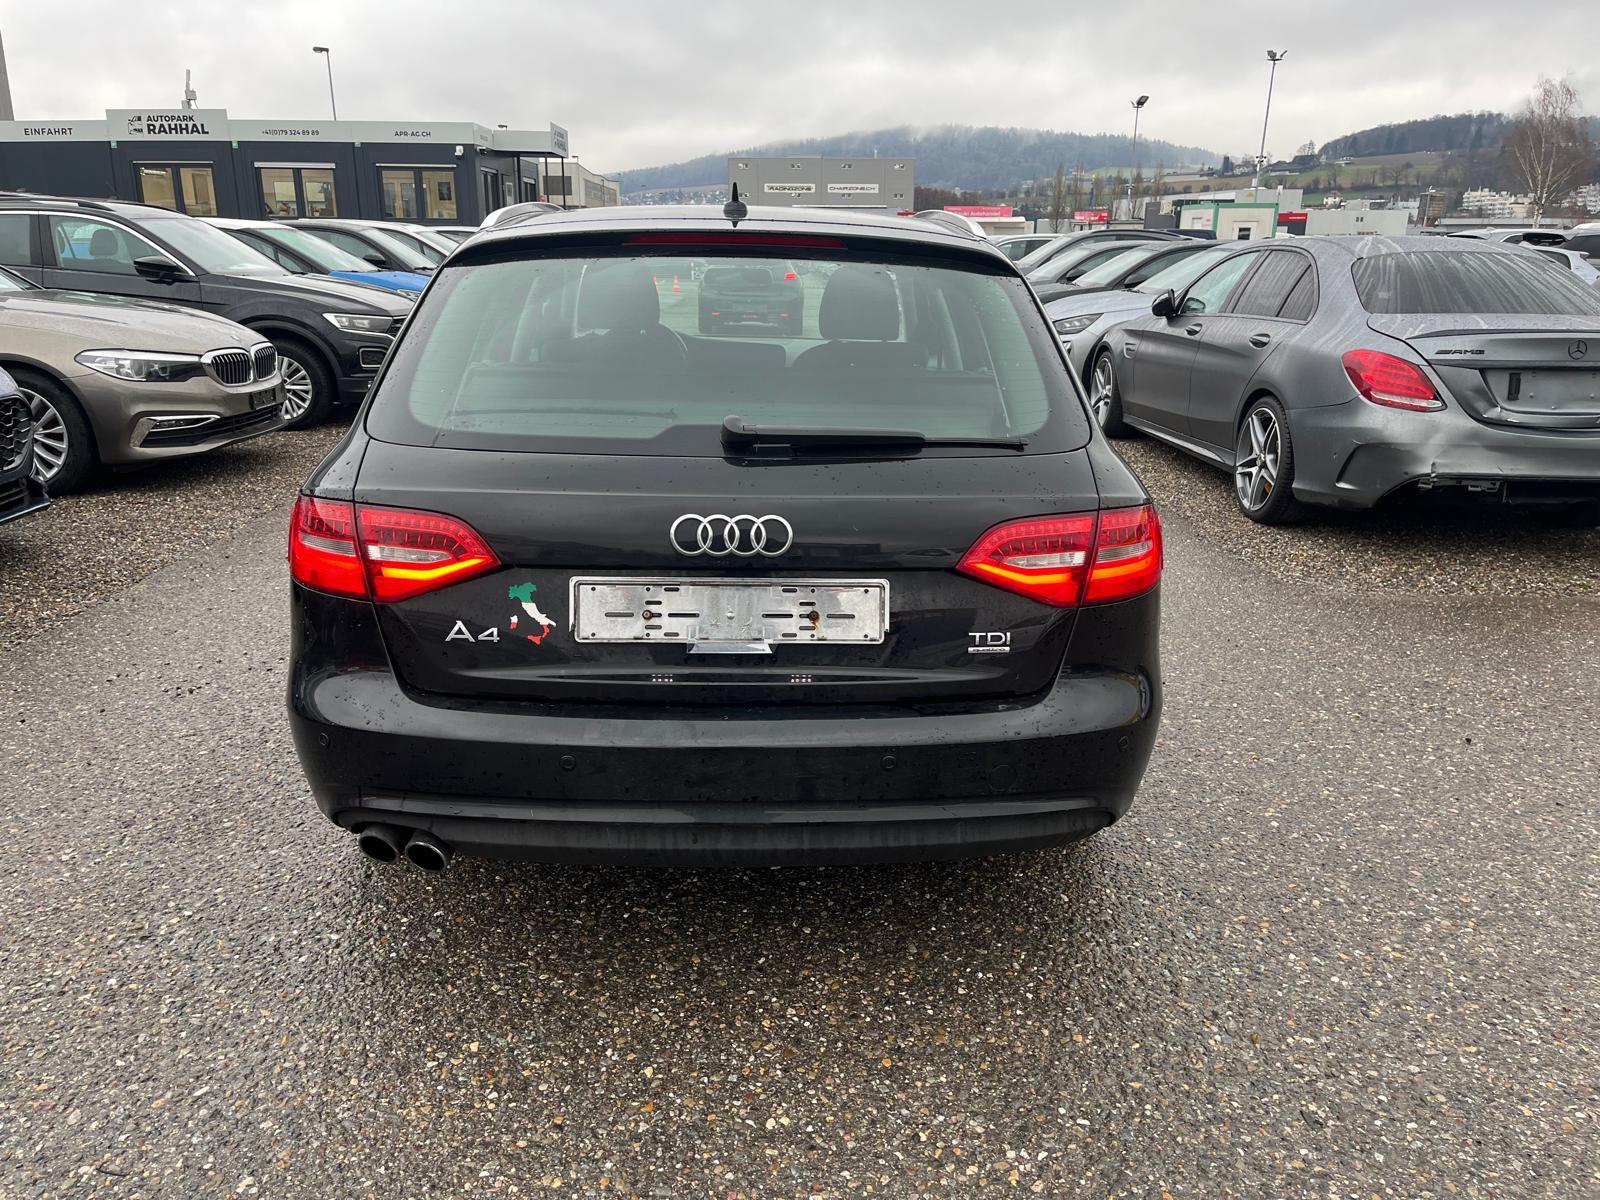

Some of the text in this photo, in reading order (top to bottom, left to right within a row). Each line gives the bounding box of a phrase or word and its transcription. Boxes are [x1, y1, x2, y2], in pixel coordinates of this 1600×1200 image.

[146, 115, 195, 123] AUTOPARK
[24, 127, 73, 136] EINFAHRT
[147, 123, 209, 135] RAHHAL
[445, 620, 500, 643] A4
[968, 632, 1011, 645] TDI
